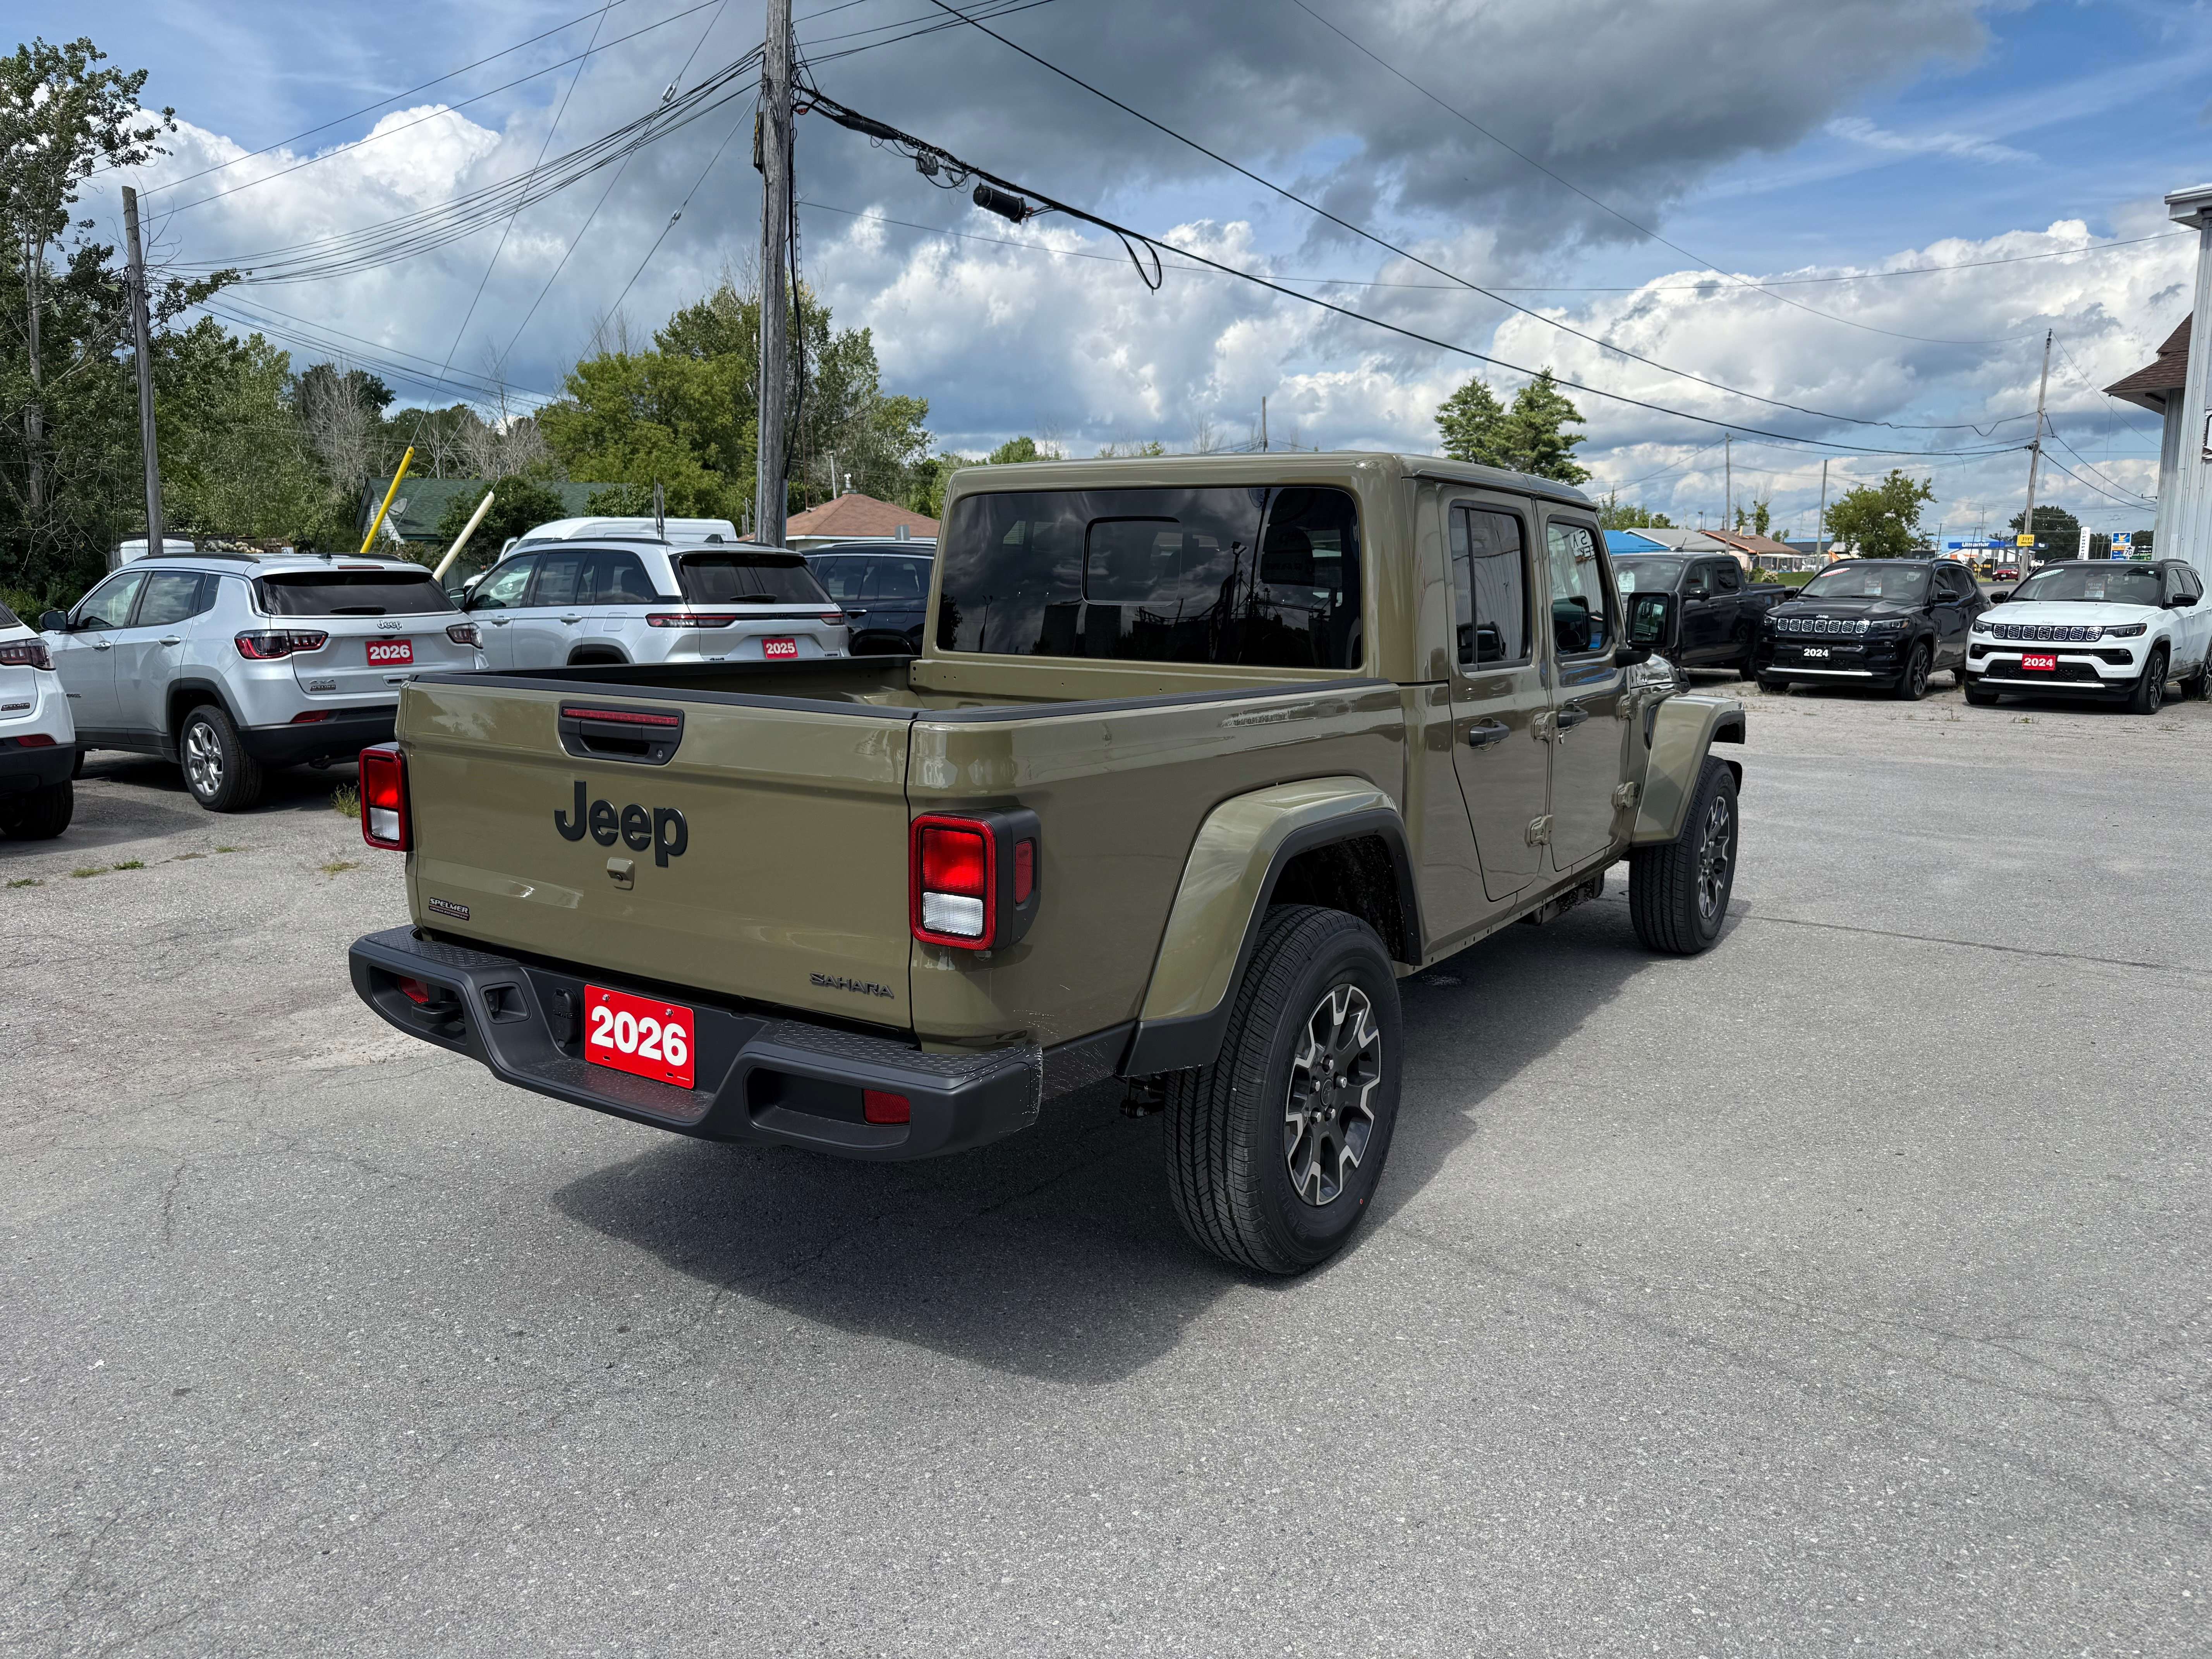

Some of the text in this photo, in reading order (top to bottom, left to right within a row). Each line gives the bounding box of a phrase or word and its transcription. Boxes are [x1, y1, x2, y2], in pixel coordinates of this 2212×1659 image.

[377, 620, 403, 630] Jeep
[370, 645, 410, 659] 2026
[766, 642, 795, 654] 2025
[1803, 648, 1829, 657] 2024
[2024, 658, 2053, 667] 2024
[554, 780, 688, 868] Jeep
[429, 898, 468, 914] SPELMER
[810, 972, 894, 999] SAHARA
[591, 1006, 687, 1066] 2026
